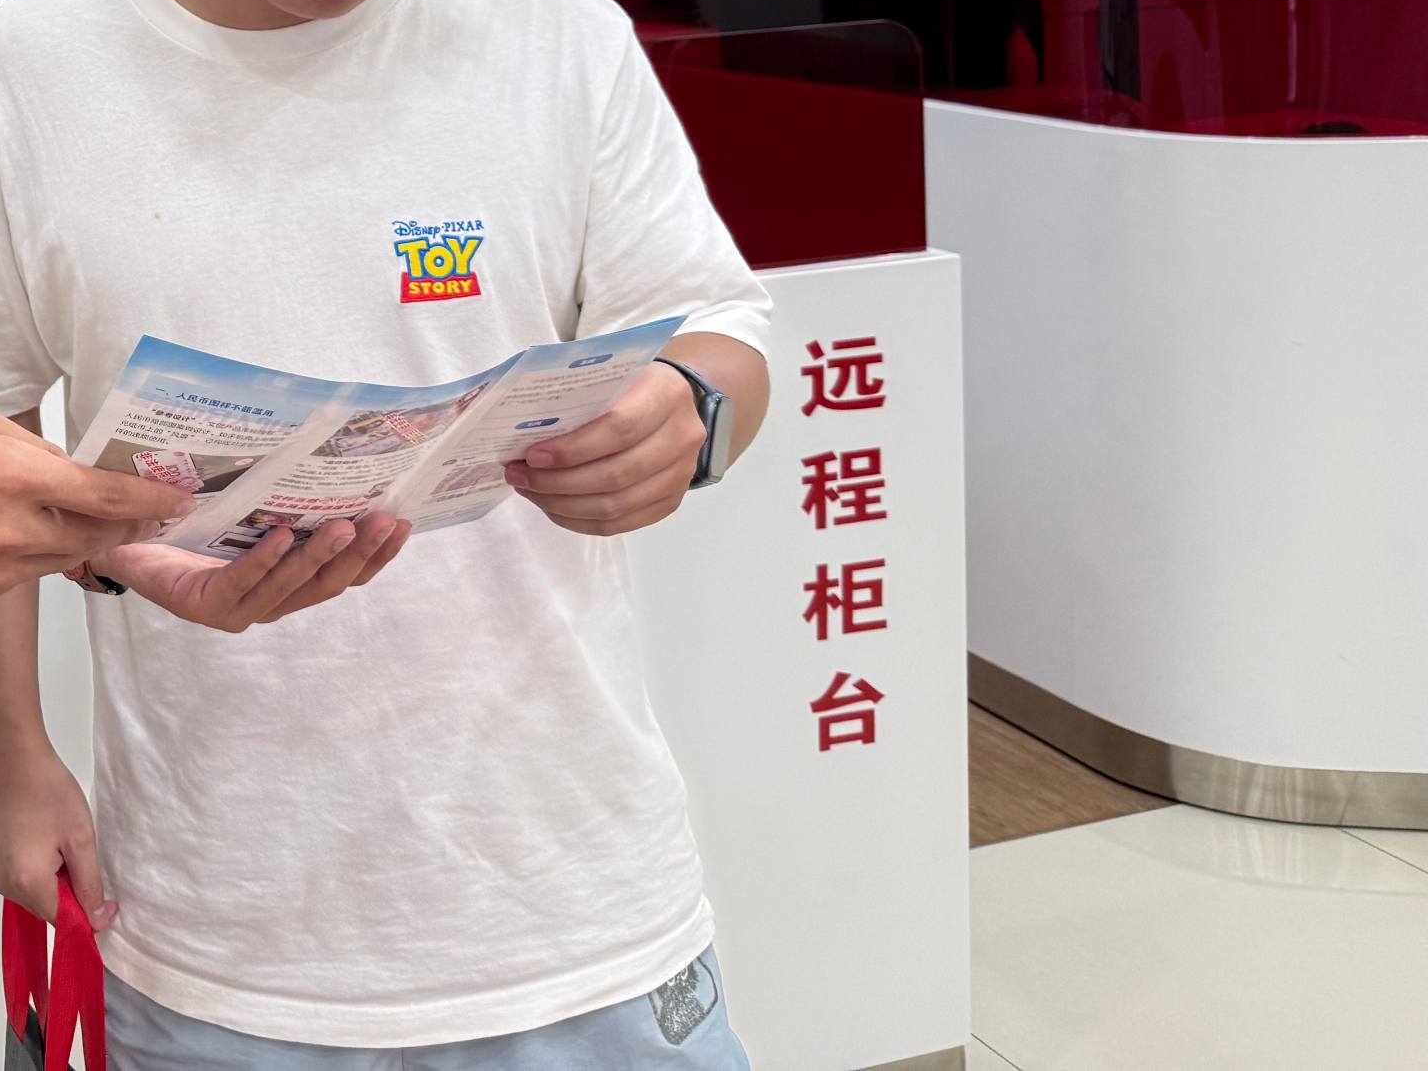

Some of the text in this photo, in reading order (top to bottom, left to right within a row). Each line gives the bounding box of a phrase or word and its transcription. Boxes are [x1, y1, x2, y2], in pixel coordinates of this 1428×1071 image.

[394, 234, 484, 281] TOY
[409, 279, 472, 295] STORY
[800, 336, 888, 752] 远程柜台
